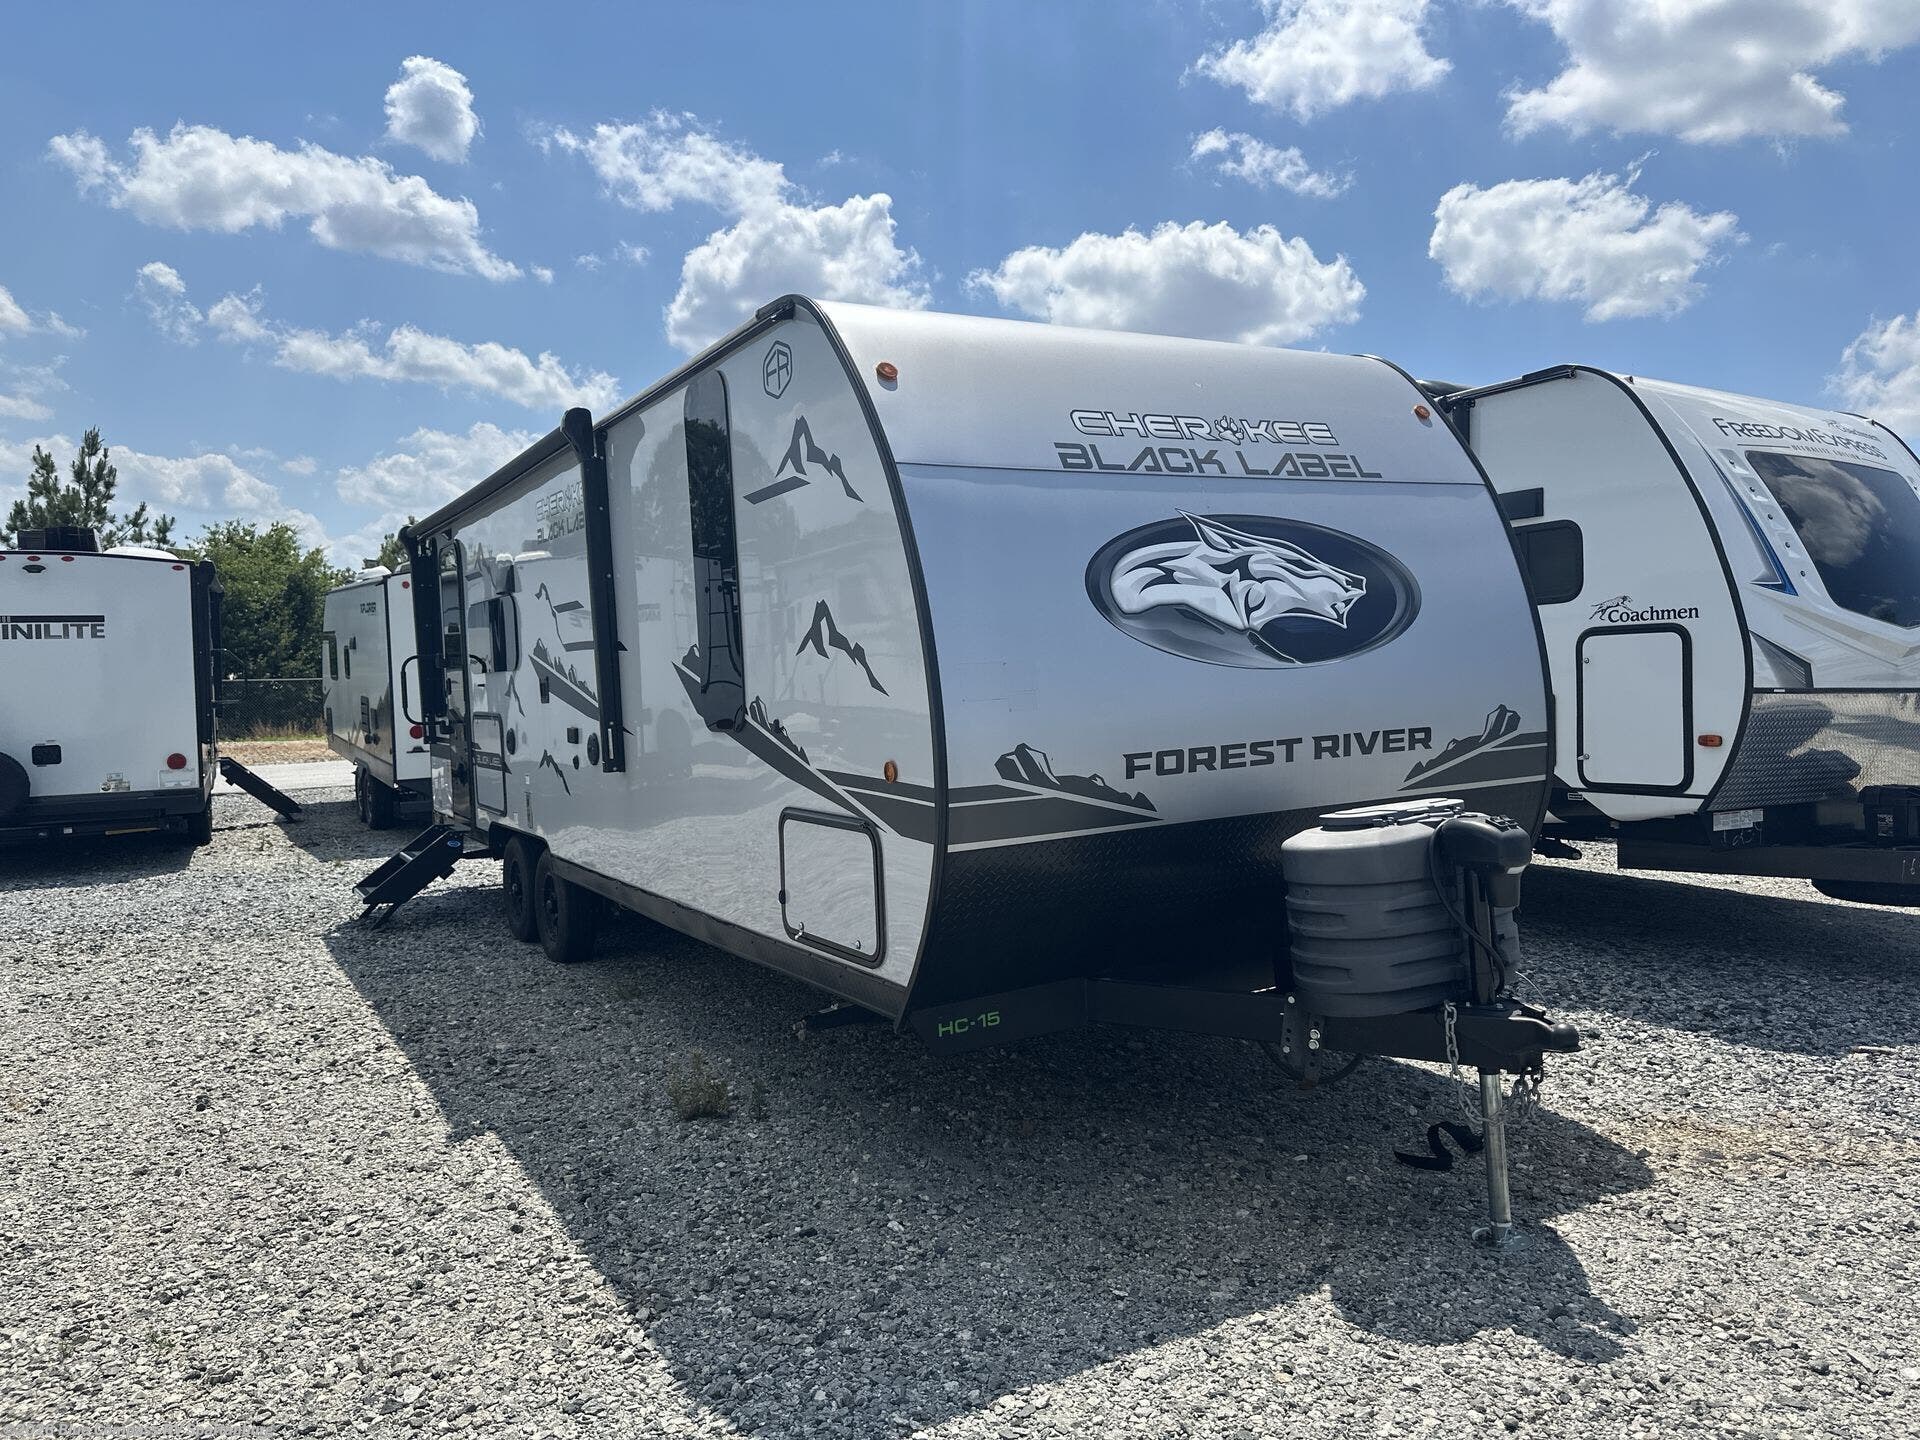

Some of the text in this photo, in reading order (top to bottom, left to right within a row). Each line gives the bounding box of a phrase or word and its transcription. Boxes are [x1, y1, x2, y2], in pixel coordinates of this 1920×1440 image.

[1054, 442, 1382, 478] BLACK LABEL
[1607, 605, 1700, 623] Coachmen
[0, 623, 105, 640] INILITE
[1122, 726, 1433, 780] FOREST RIVER
